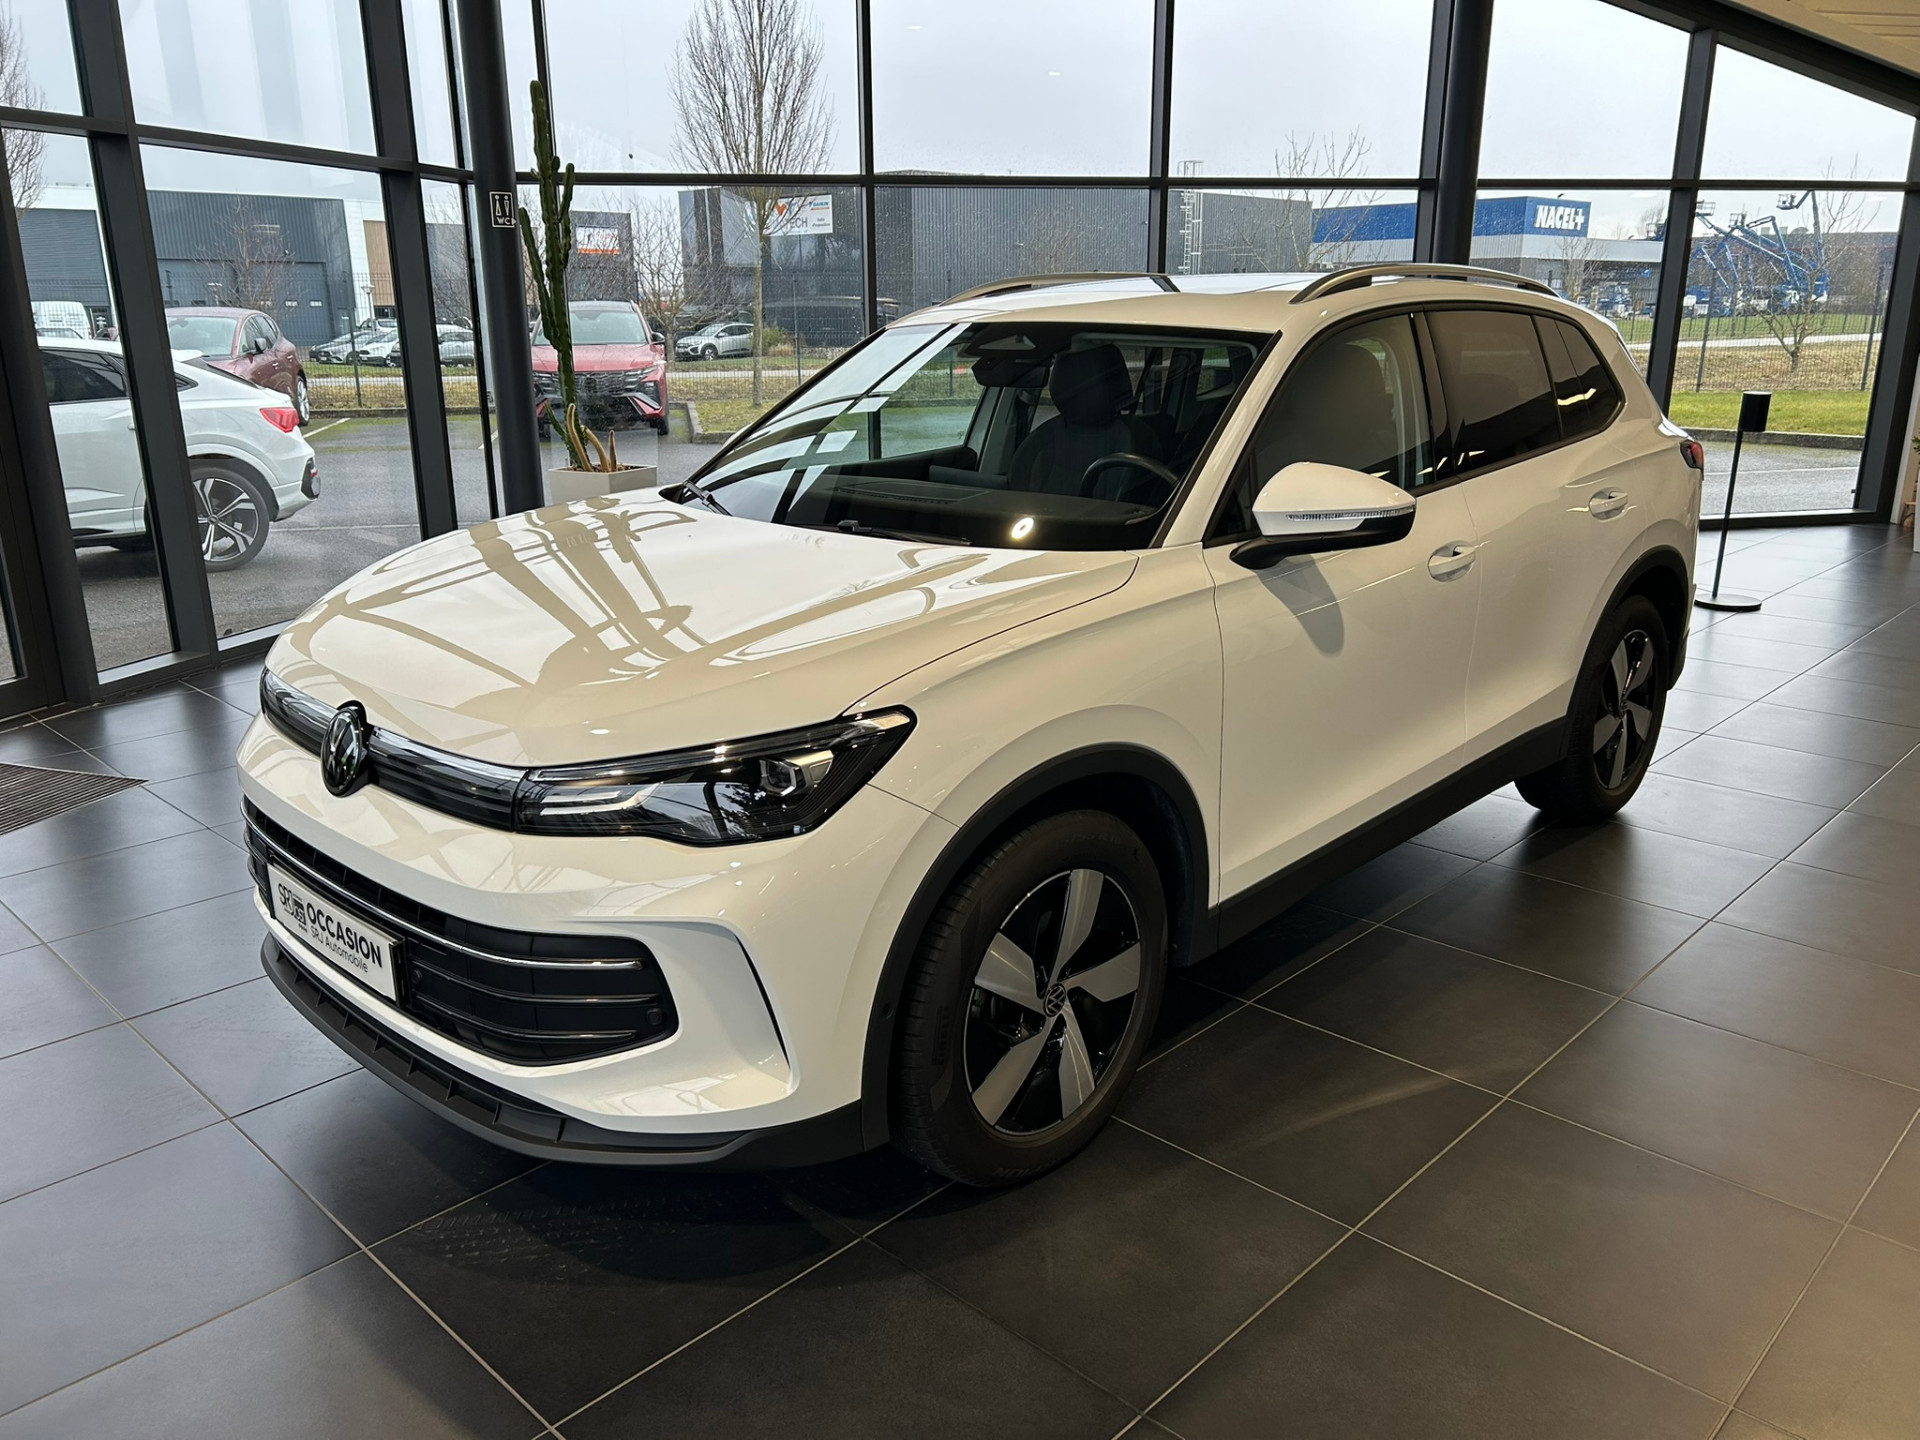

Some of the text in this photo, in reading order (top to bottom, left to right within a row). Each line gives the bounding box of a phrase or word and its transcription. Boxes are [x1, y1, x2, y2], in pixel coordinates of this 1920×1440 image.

[496, 217, 511, 225] WC
[306, 902, 382, 968] OCCASION
[311, 925, 368, 973] SRJ Automobile
